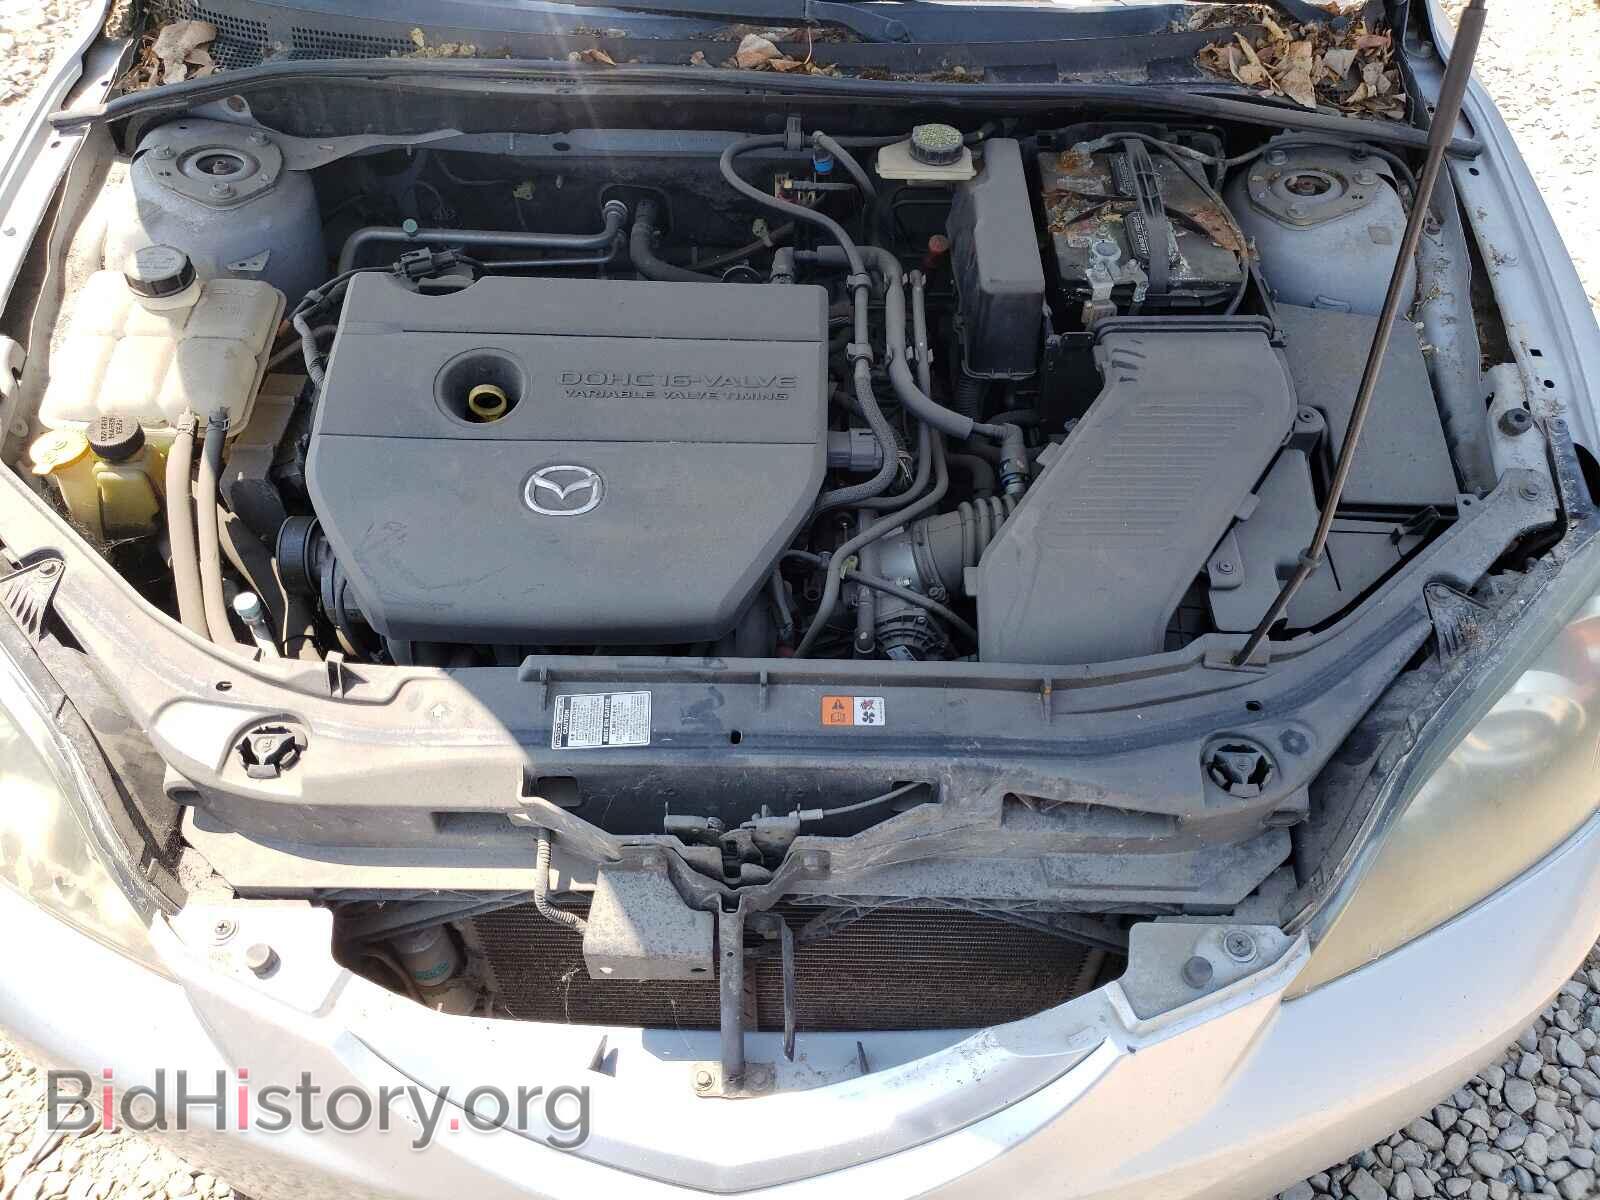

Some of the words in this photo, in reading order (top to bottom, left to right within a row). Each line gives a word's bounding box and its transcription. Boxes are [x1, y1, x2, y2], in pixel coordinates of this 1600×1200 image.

[560, 371, 655, 387] DOHC
[663, 374, 799, 389] 16-VALVE
[565, 389, 656, 399] VARIABLE
[663, 391, 721, 400] VALVE
[722, 392, 789, 401] TIMING
[562, 708, 570, 735] CAUTION
